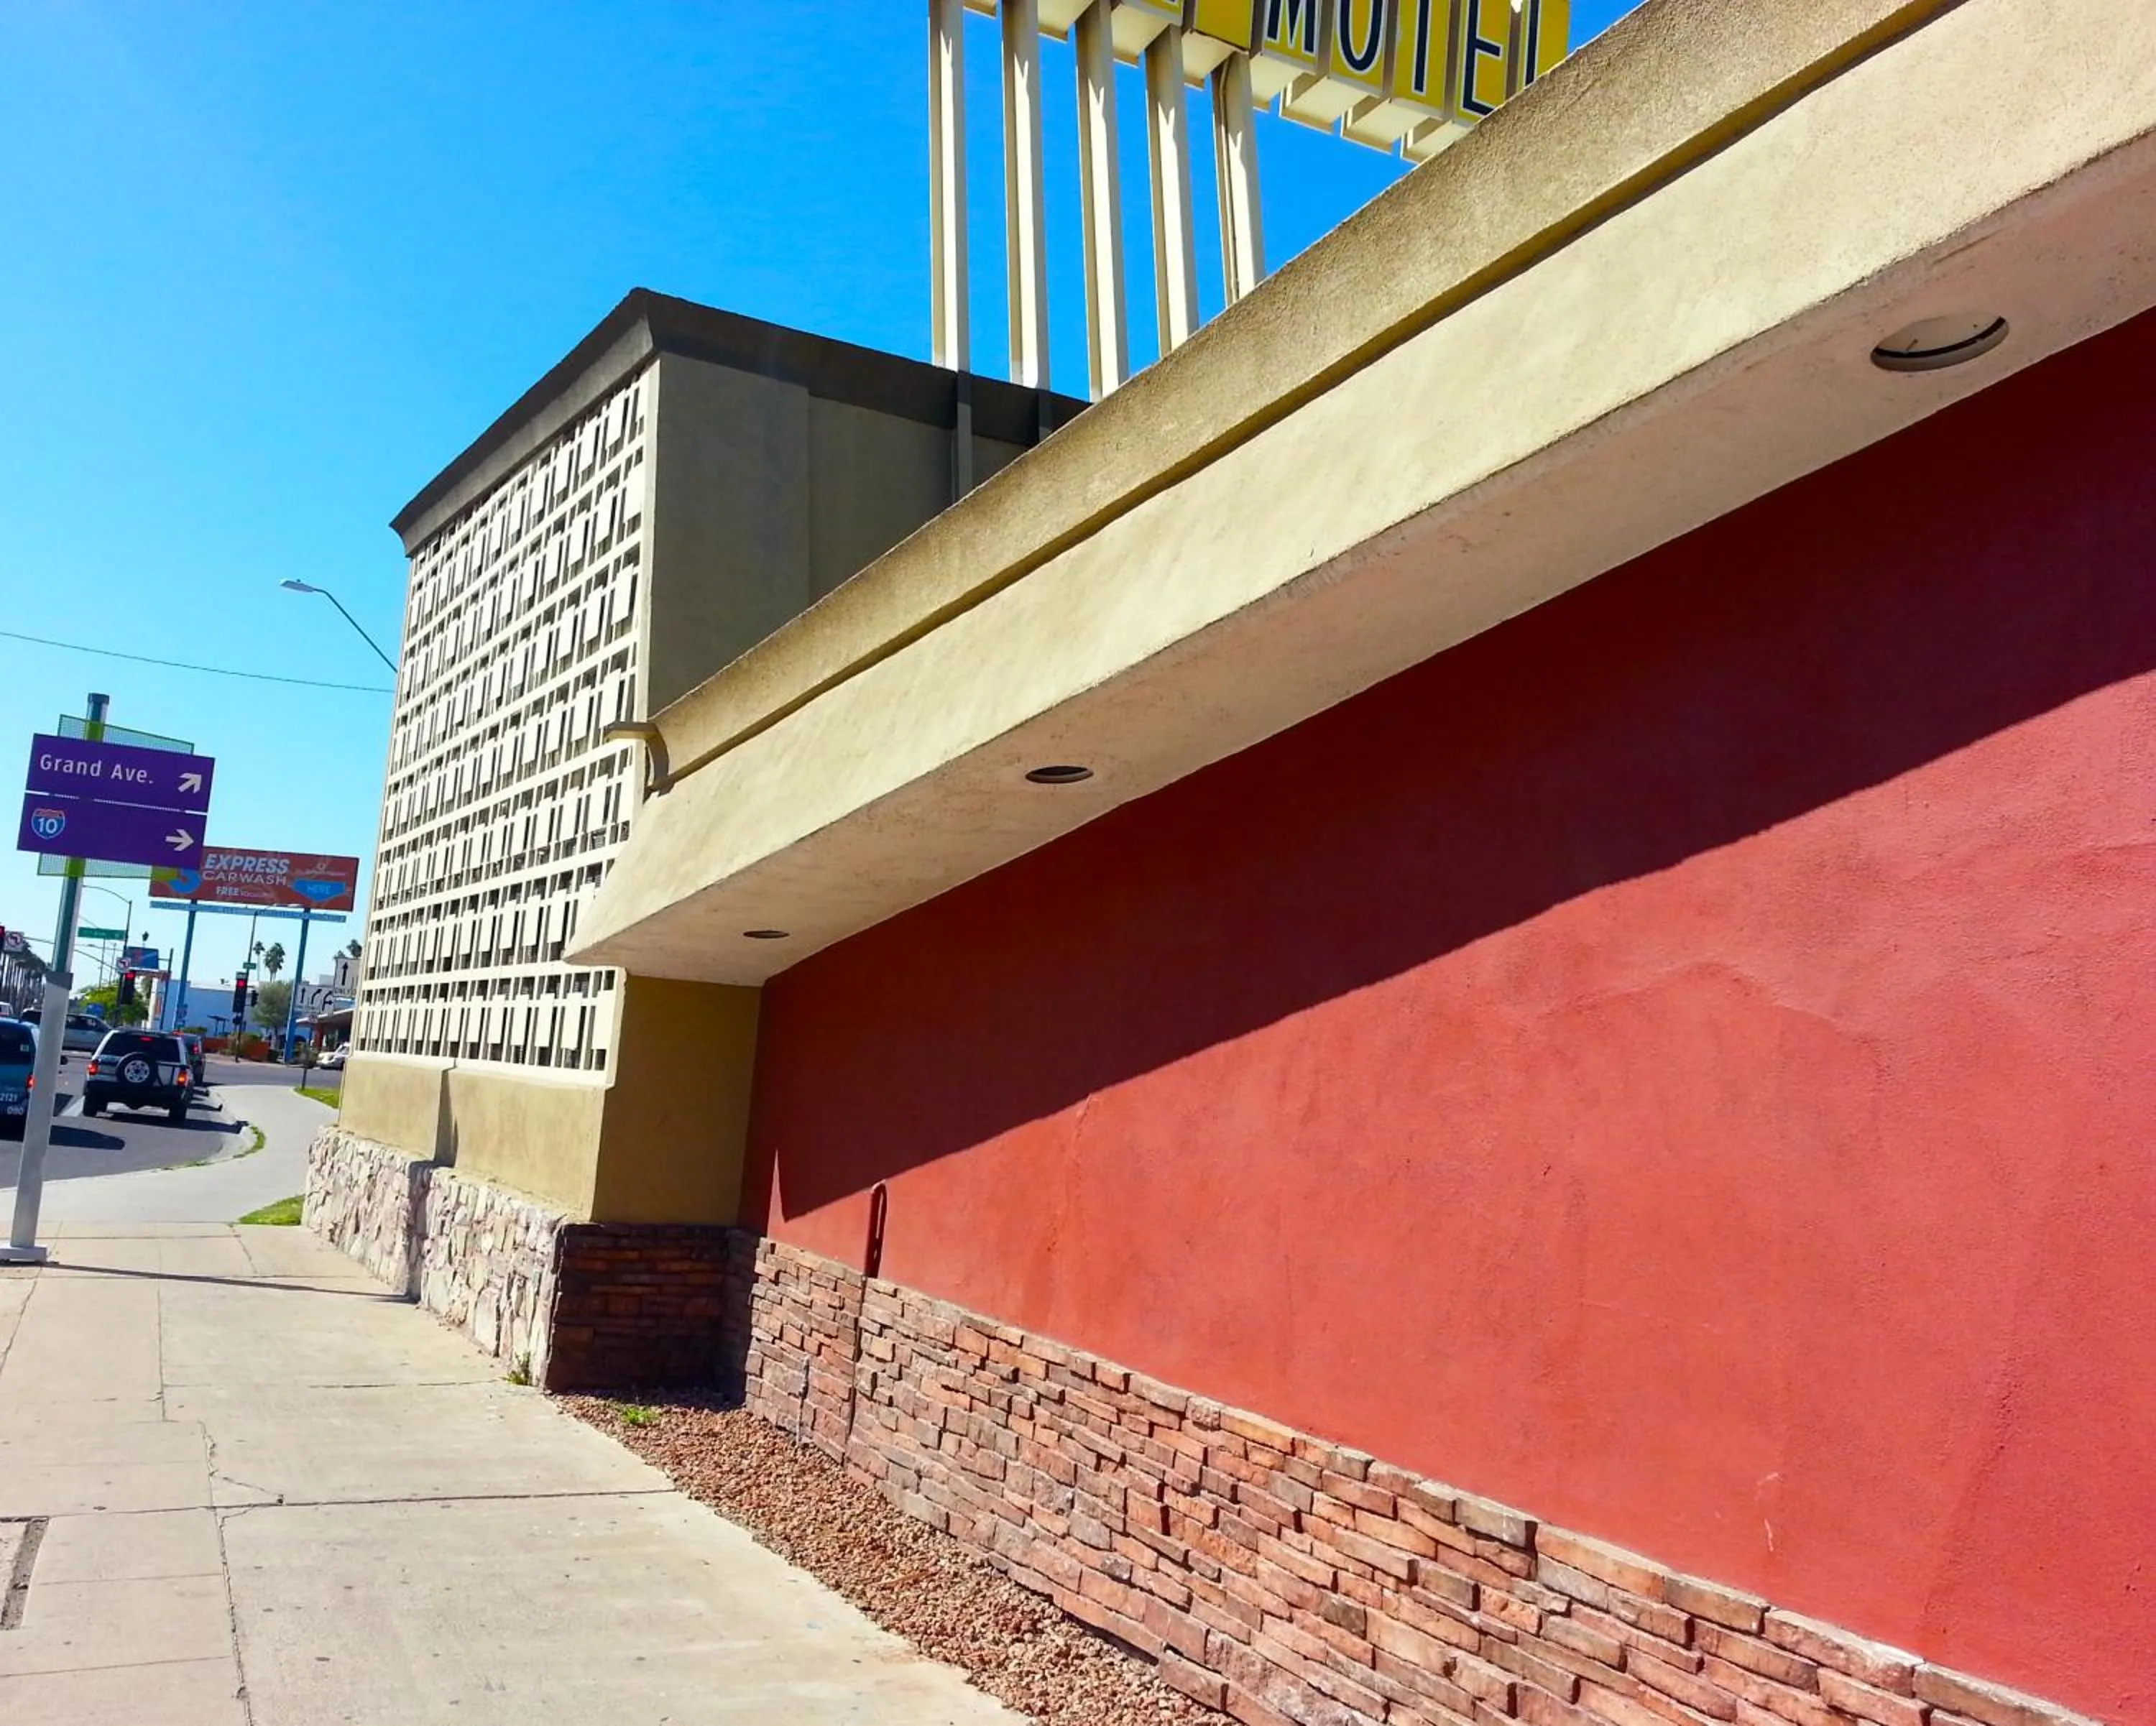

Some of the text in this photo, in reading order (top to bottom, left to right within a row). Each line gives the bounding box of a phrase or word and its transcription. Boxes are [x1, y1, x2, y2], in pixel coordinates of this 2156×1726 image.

[40, 754, 154, 784] Grand Ave.
[37, 818, 58, 834] 10
[204, 854, 290, 874] EXPRESS
[202, 870, 287, 886] CARWASH
[216, 886, 239, 897] FREE
